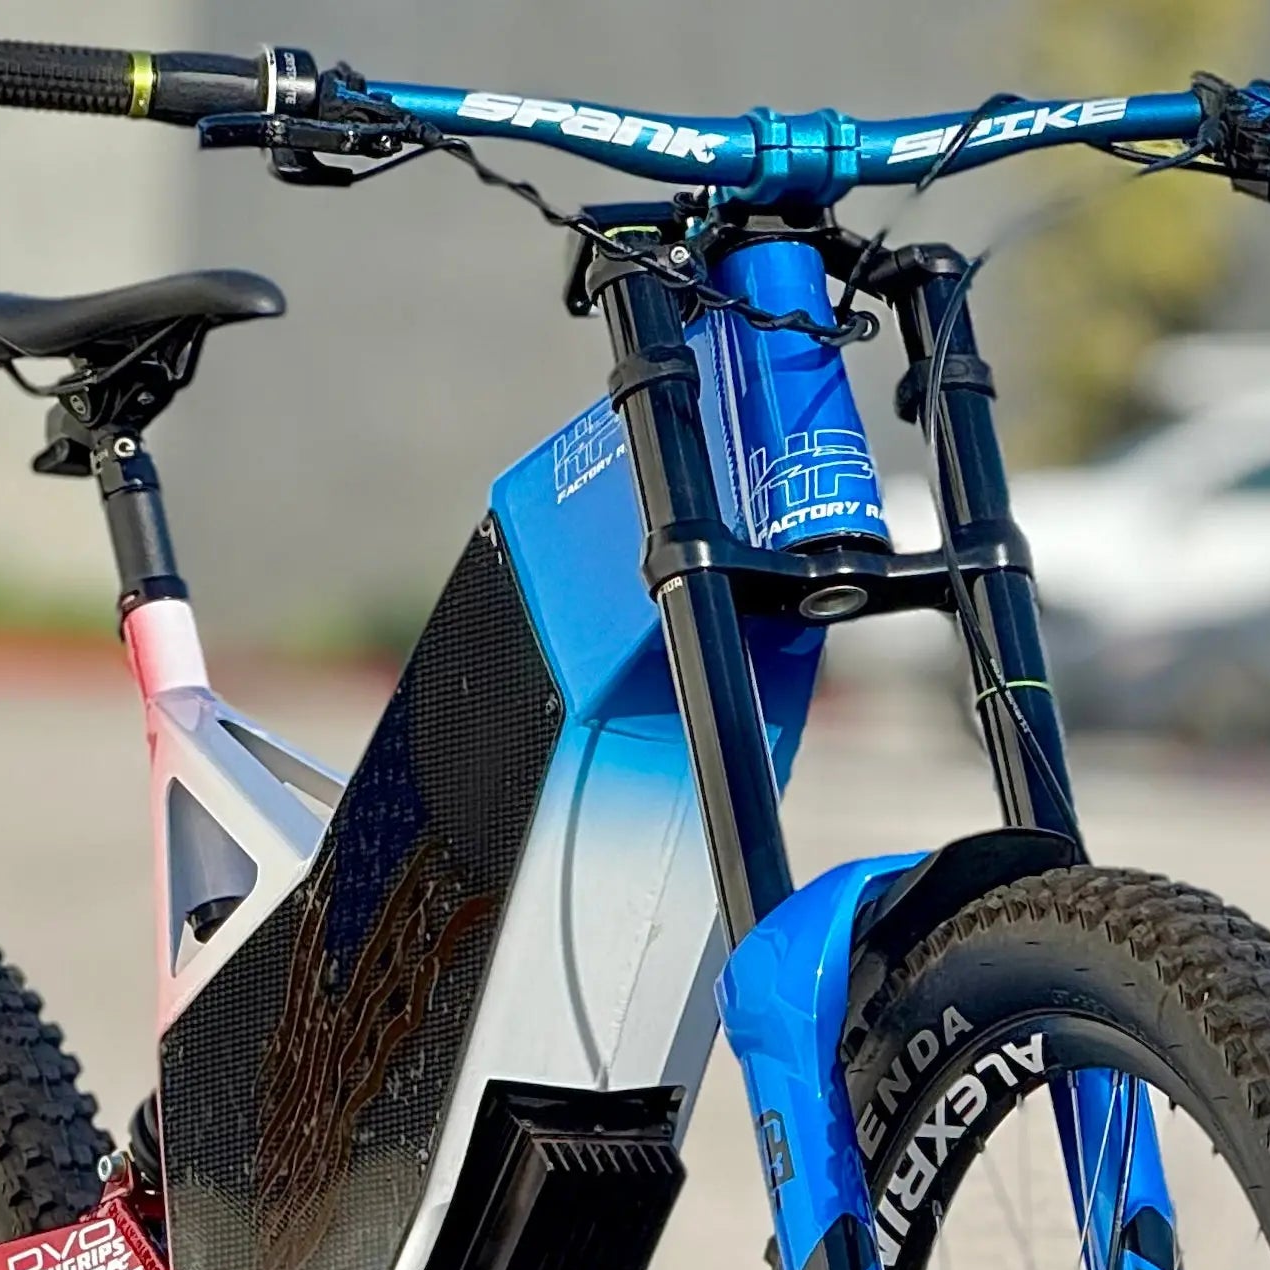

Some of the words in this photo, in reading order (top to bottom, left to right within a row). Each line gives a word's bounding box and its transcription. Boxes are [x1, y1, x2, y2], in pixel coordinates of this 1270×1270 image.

[887, 98, 1128, 165] SPIKE
[557, 452, 613, 505] FACTORY
[856, 1005, 974, 1161] ENDA
